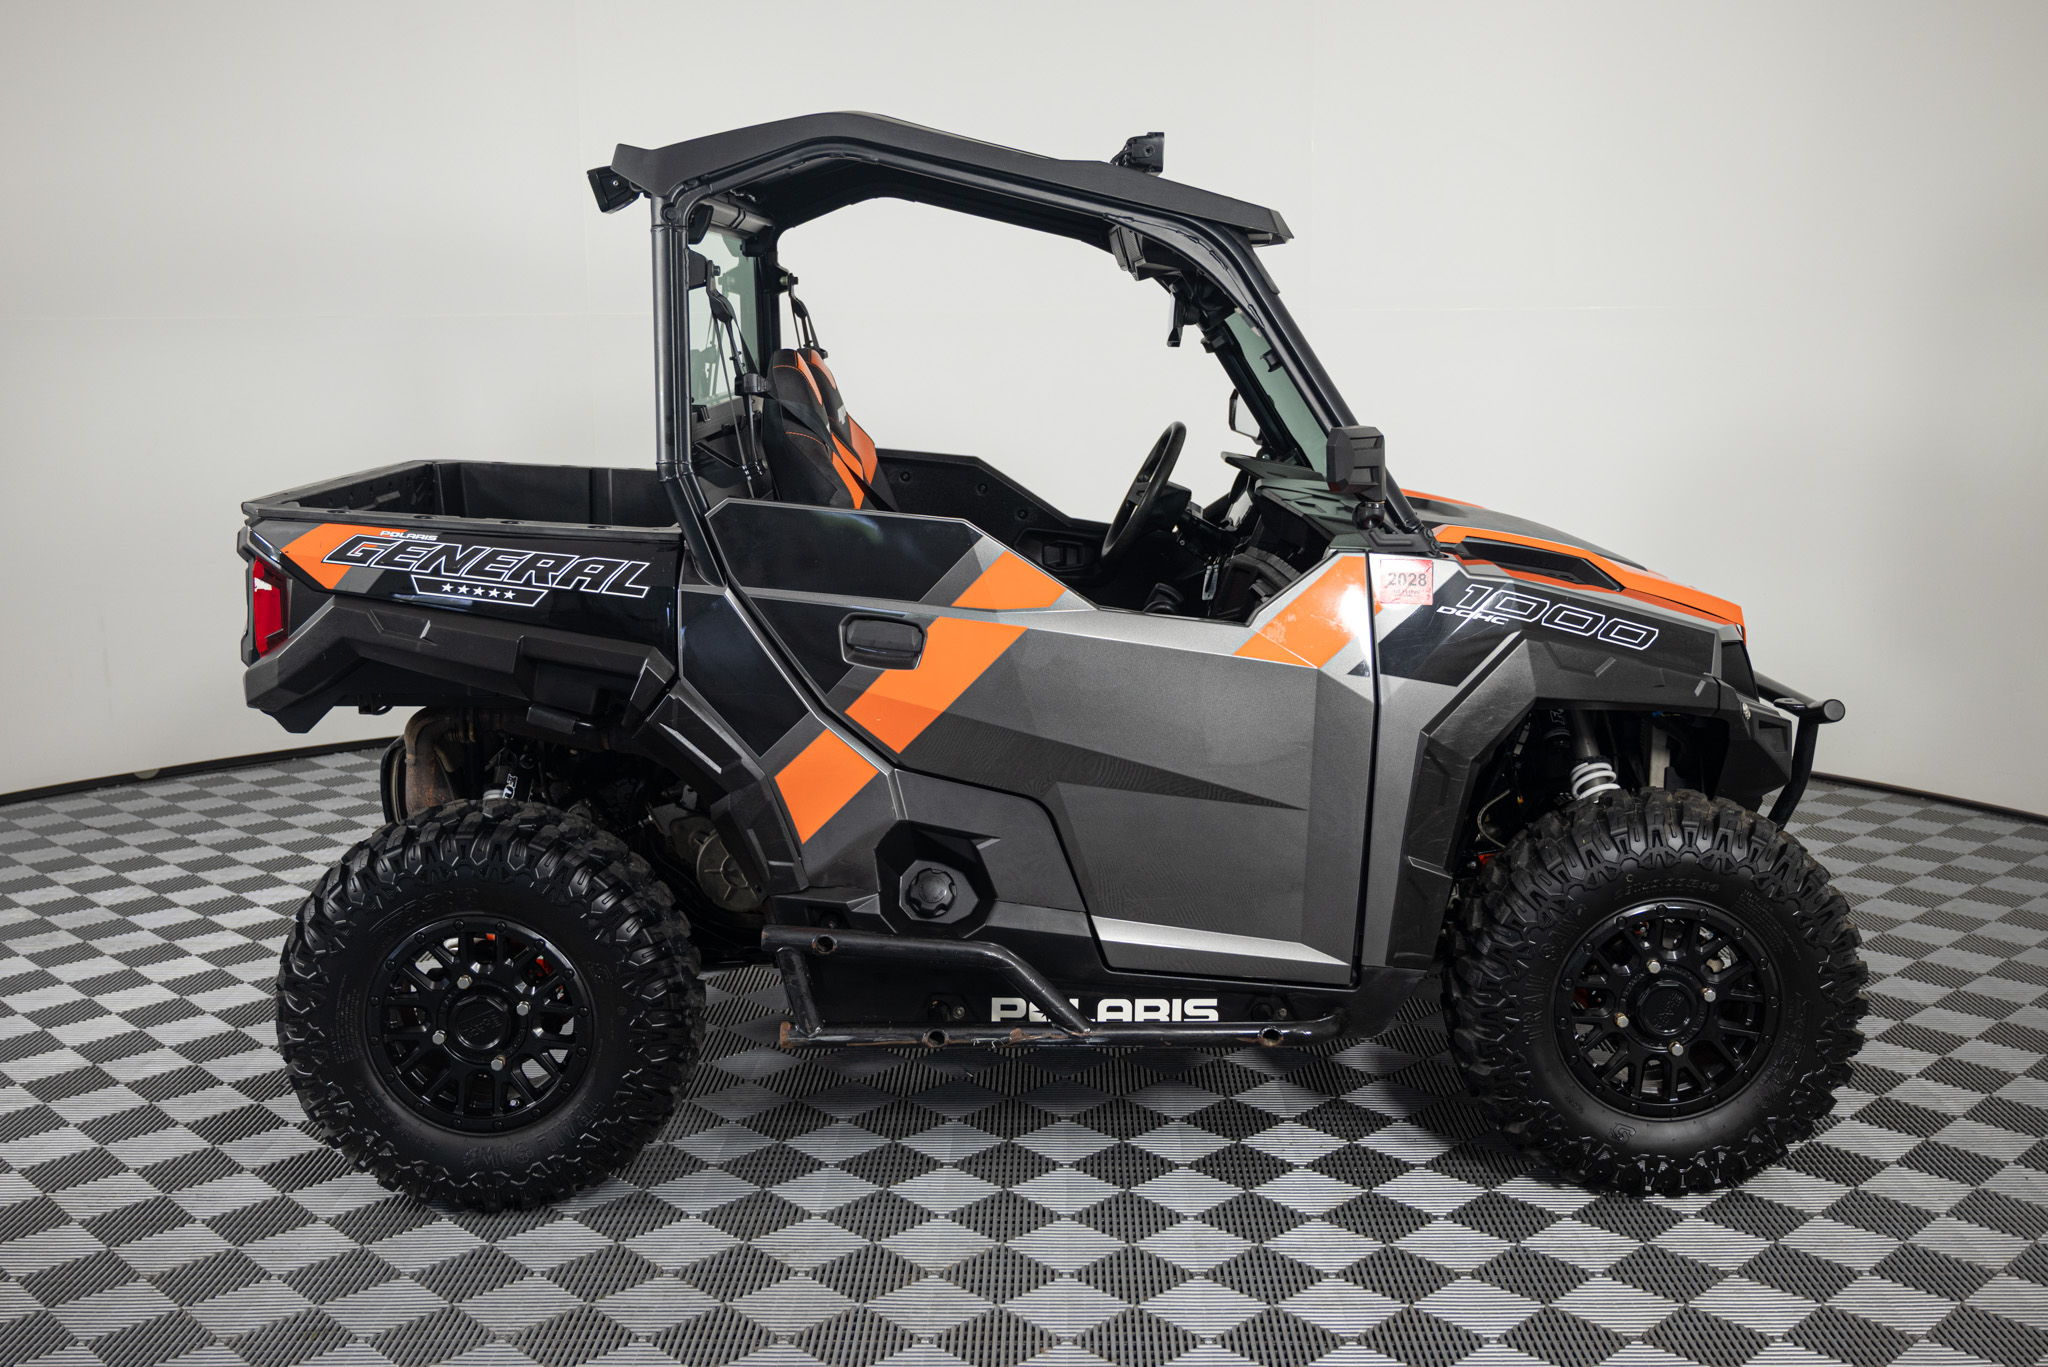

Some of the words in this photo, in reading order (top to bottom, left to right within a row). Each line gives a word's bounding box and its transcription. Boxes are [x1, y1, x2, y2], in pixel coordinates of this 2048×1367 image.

[379, 530, 439, 541] POLARIS
[321, 533, 651, 599] GENERAL
[1387, 572, 1427, 587] 2028
[1455, 583, 1660, 651] 1000
[991, 997, 1219, 1022] PARIS
